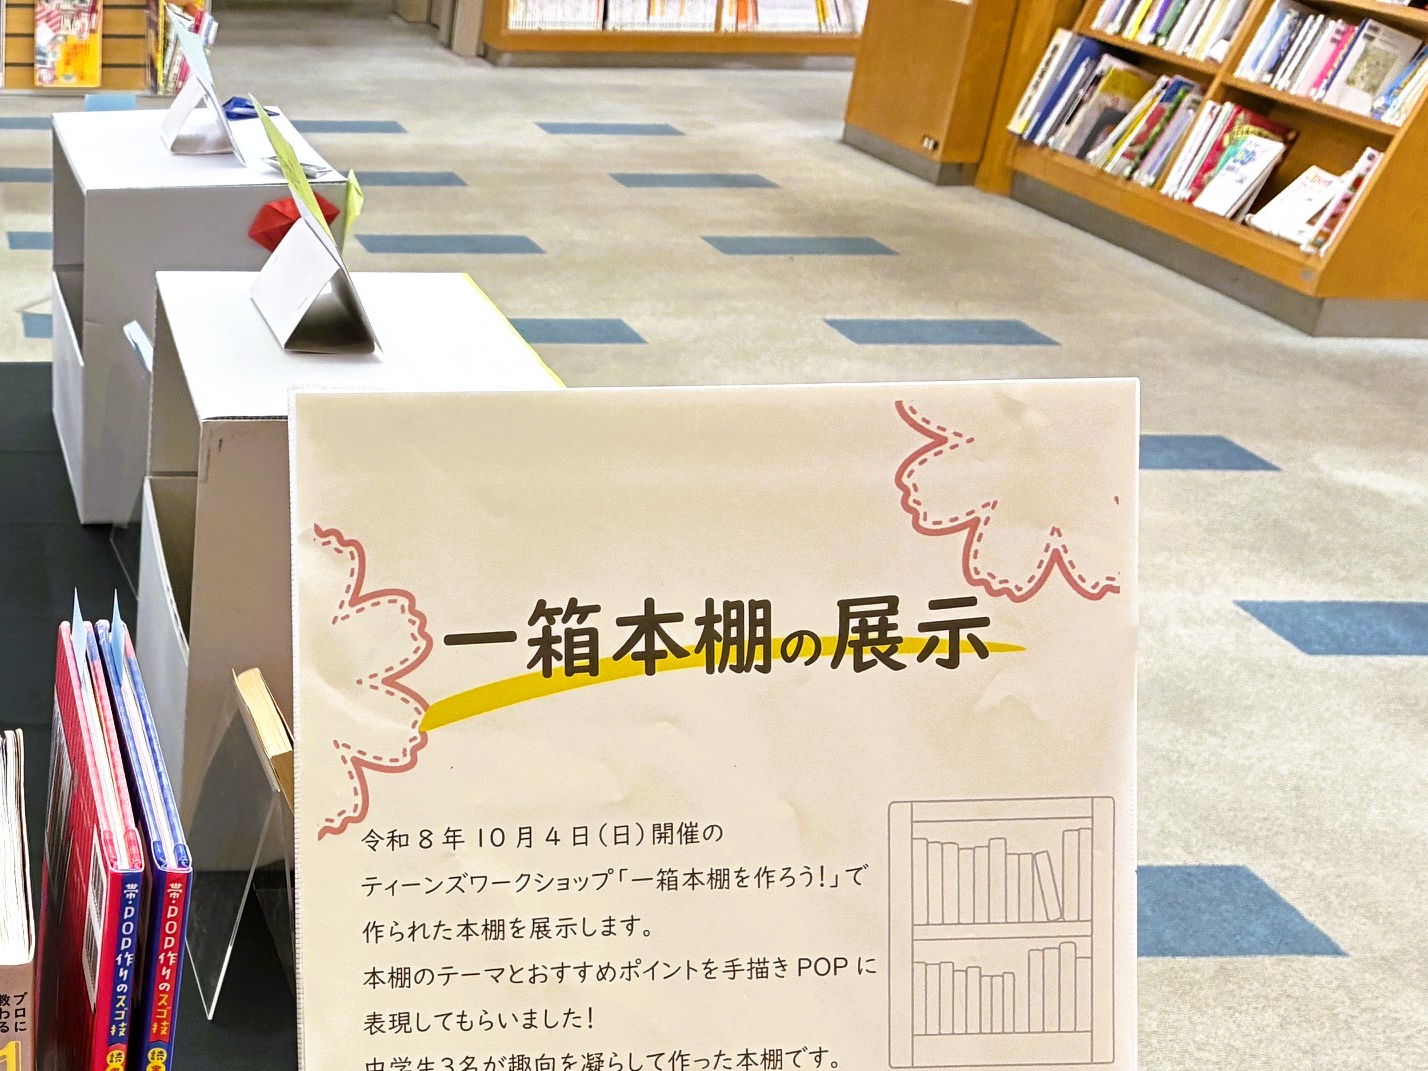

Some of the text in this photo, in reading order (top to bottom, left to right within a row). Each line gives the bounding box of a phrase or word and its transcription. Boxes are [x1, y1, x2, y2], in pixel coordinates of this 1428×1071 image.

[443, 595, 991, 679] 一箱本棚の展示
[362, 914, 654, 945] 作られた本棚を展示します。
[13, 990, 28, 1033] プロに
[363, 1007, 595, 1037] 表現してもらいました！
